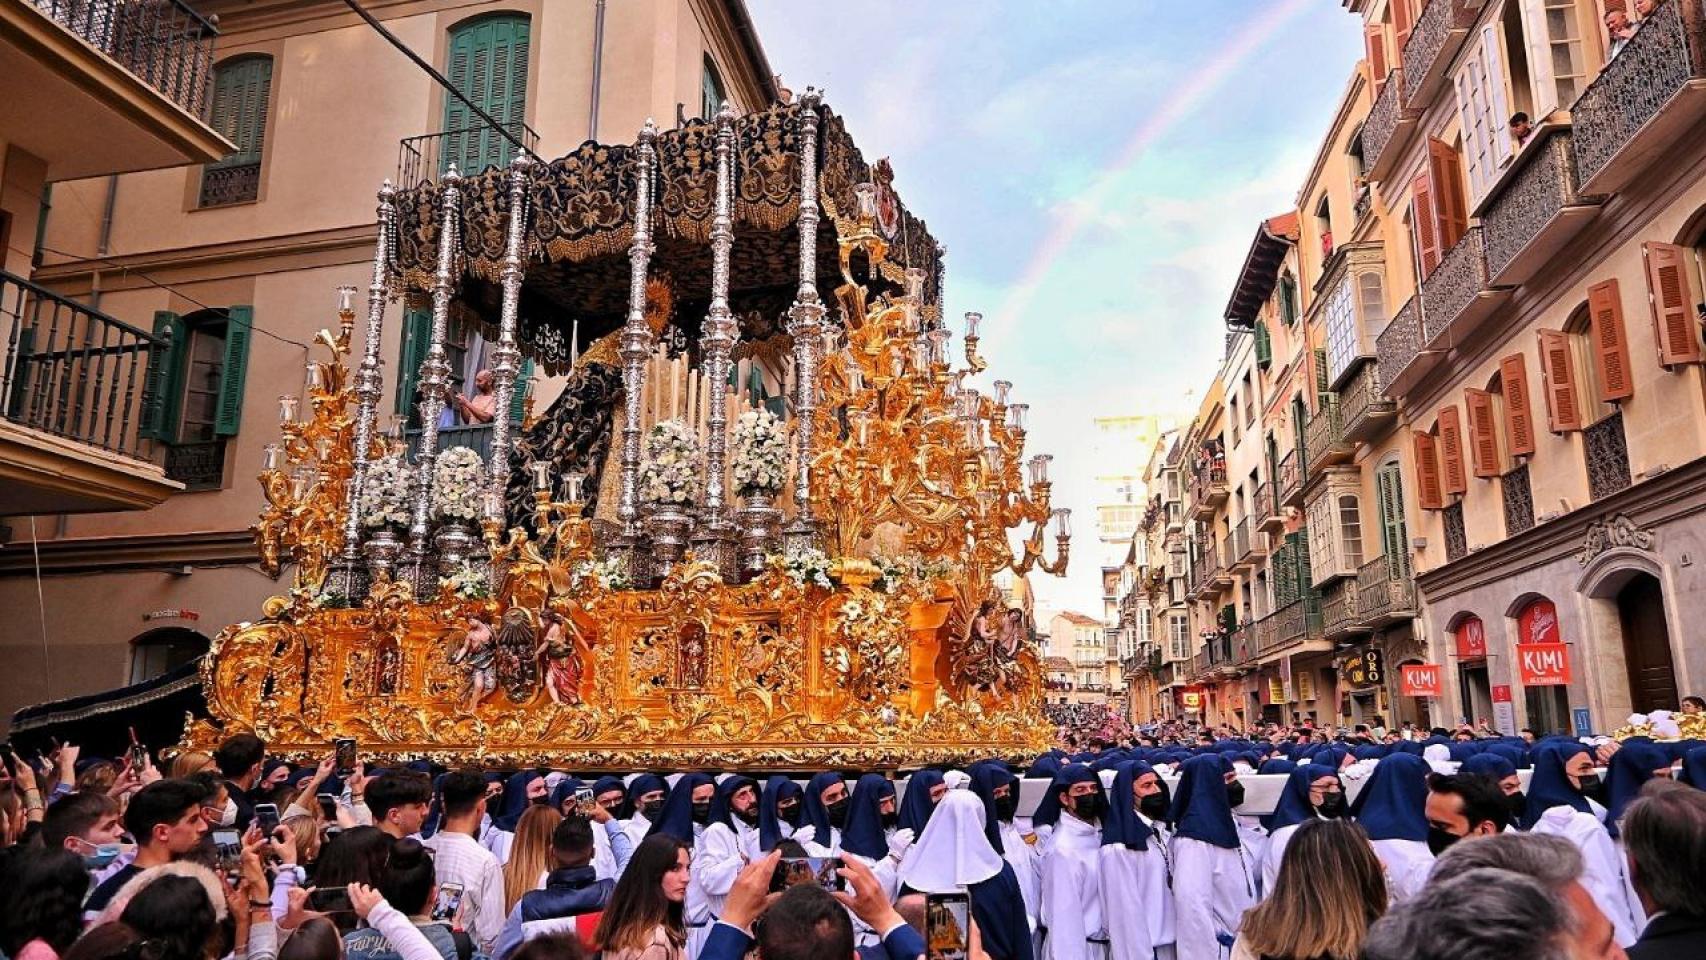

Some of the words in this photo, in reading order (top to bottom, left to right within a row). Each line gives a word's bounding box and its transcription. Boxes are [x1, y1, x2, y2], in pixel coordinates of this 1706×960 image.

[1366, 651, 1379, 681] ORO
[1523, 650, 1563, 675] KIMI
[1407, 671, 1436, 689] KIMI
